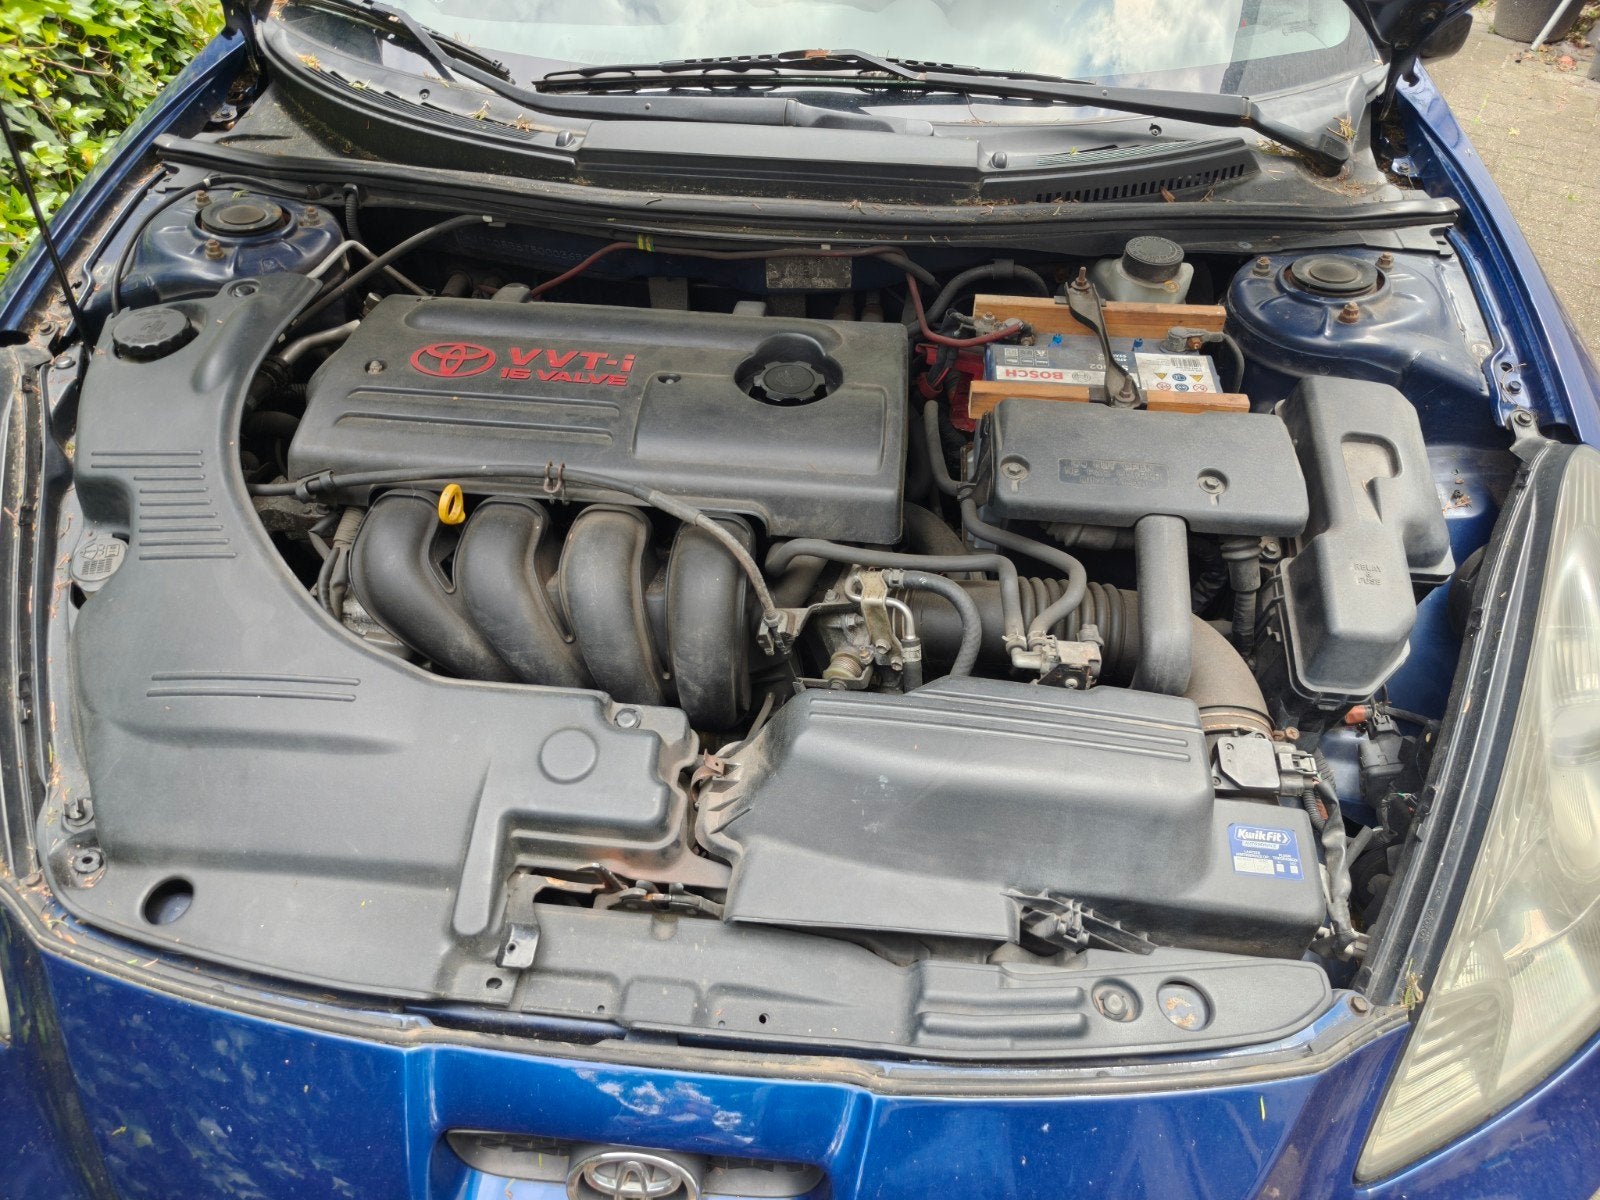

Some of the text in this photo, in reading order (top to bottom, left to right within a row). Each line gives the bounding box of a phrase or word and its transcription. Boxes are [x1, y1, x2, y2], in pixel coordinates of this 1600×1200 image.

[509, 346, 636, 373] VVT-i
[501, 367, 629, 387] 16 VALVE
[1005, 369, 1064, 380] BOSCH
